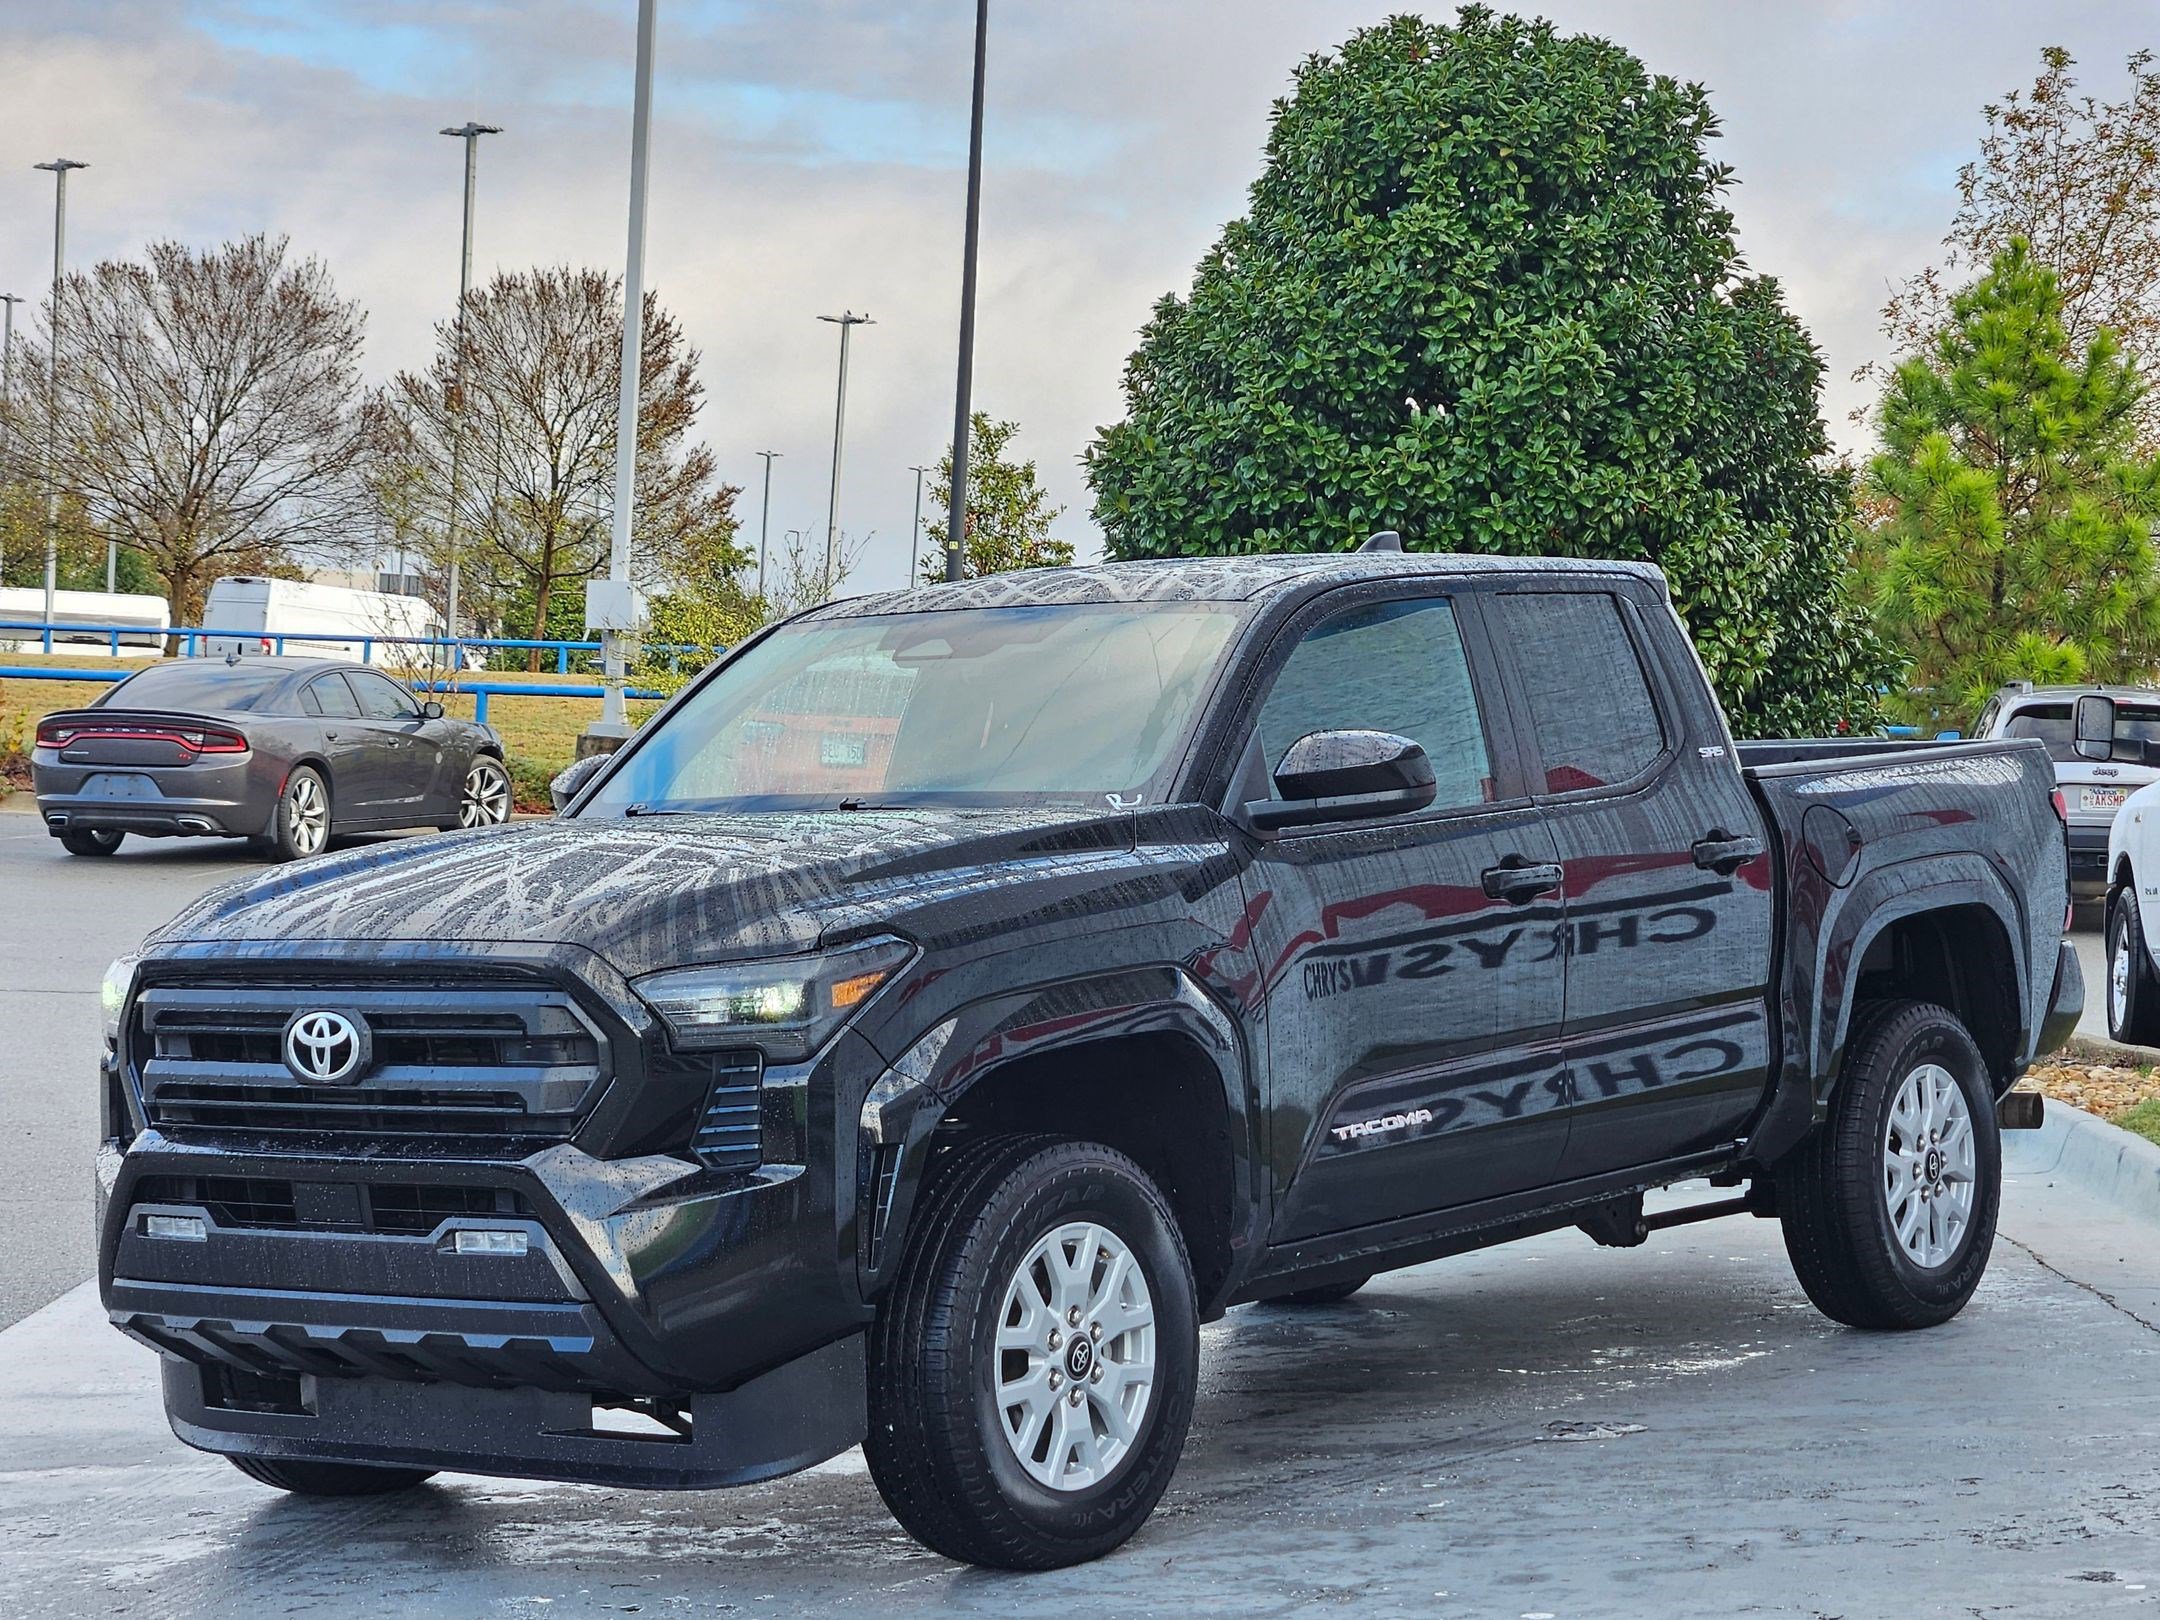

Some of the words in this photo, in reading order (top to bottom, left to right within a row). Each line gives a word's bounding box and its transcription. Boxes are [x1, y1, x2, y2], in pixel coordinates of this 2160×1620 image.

[1698, 745, 1724, 758] SR5
[2092, 766, 2119, 777] Jeep
[1331, 1108, 1433, 1141] TACOMA
